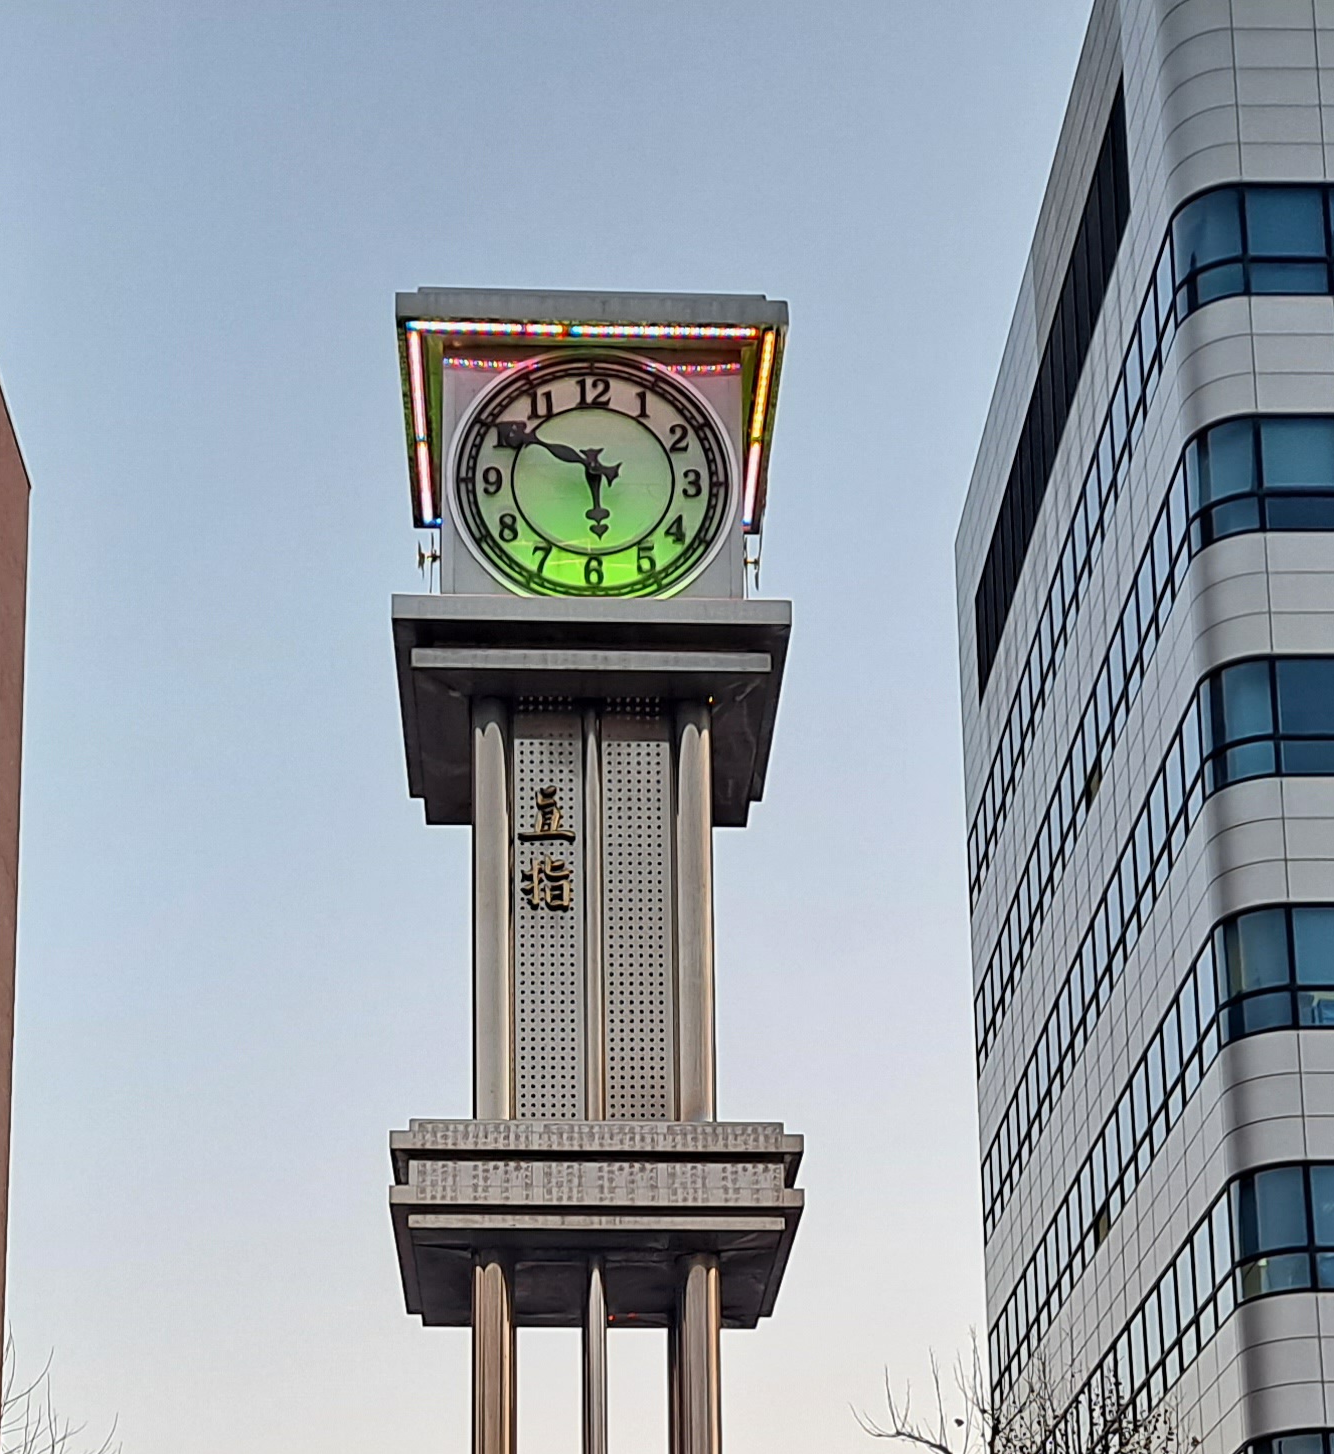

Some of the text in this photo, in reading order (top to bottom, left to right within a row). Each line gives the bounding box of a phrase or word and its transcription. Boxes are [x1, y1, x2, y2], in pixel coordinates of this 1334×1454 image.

[528, 390, 554, 419] 11
[575, 377, 611, 407] 12
[635, 390, 650, 418] 1
[670, 424, 689, 452] 2
[482, 467, 503, 496] 9
[682, 469, 702, 498] 3
[498, 513, 519, 543] 8
[665, 515, 686, 544] 4
[532, 545, 552, 575] 7
[584, 556, 603, 586] 6
[636, 544, 656, 576] 5
